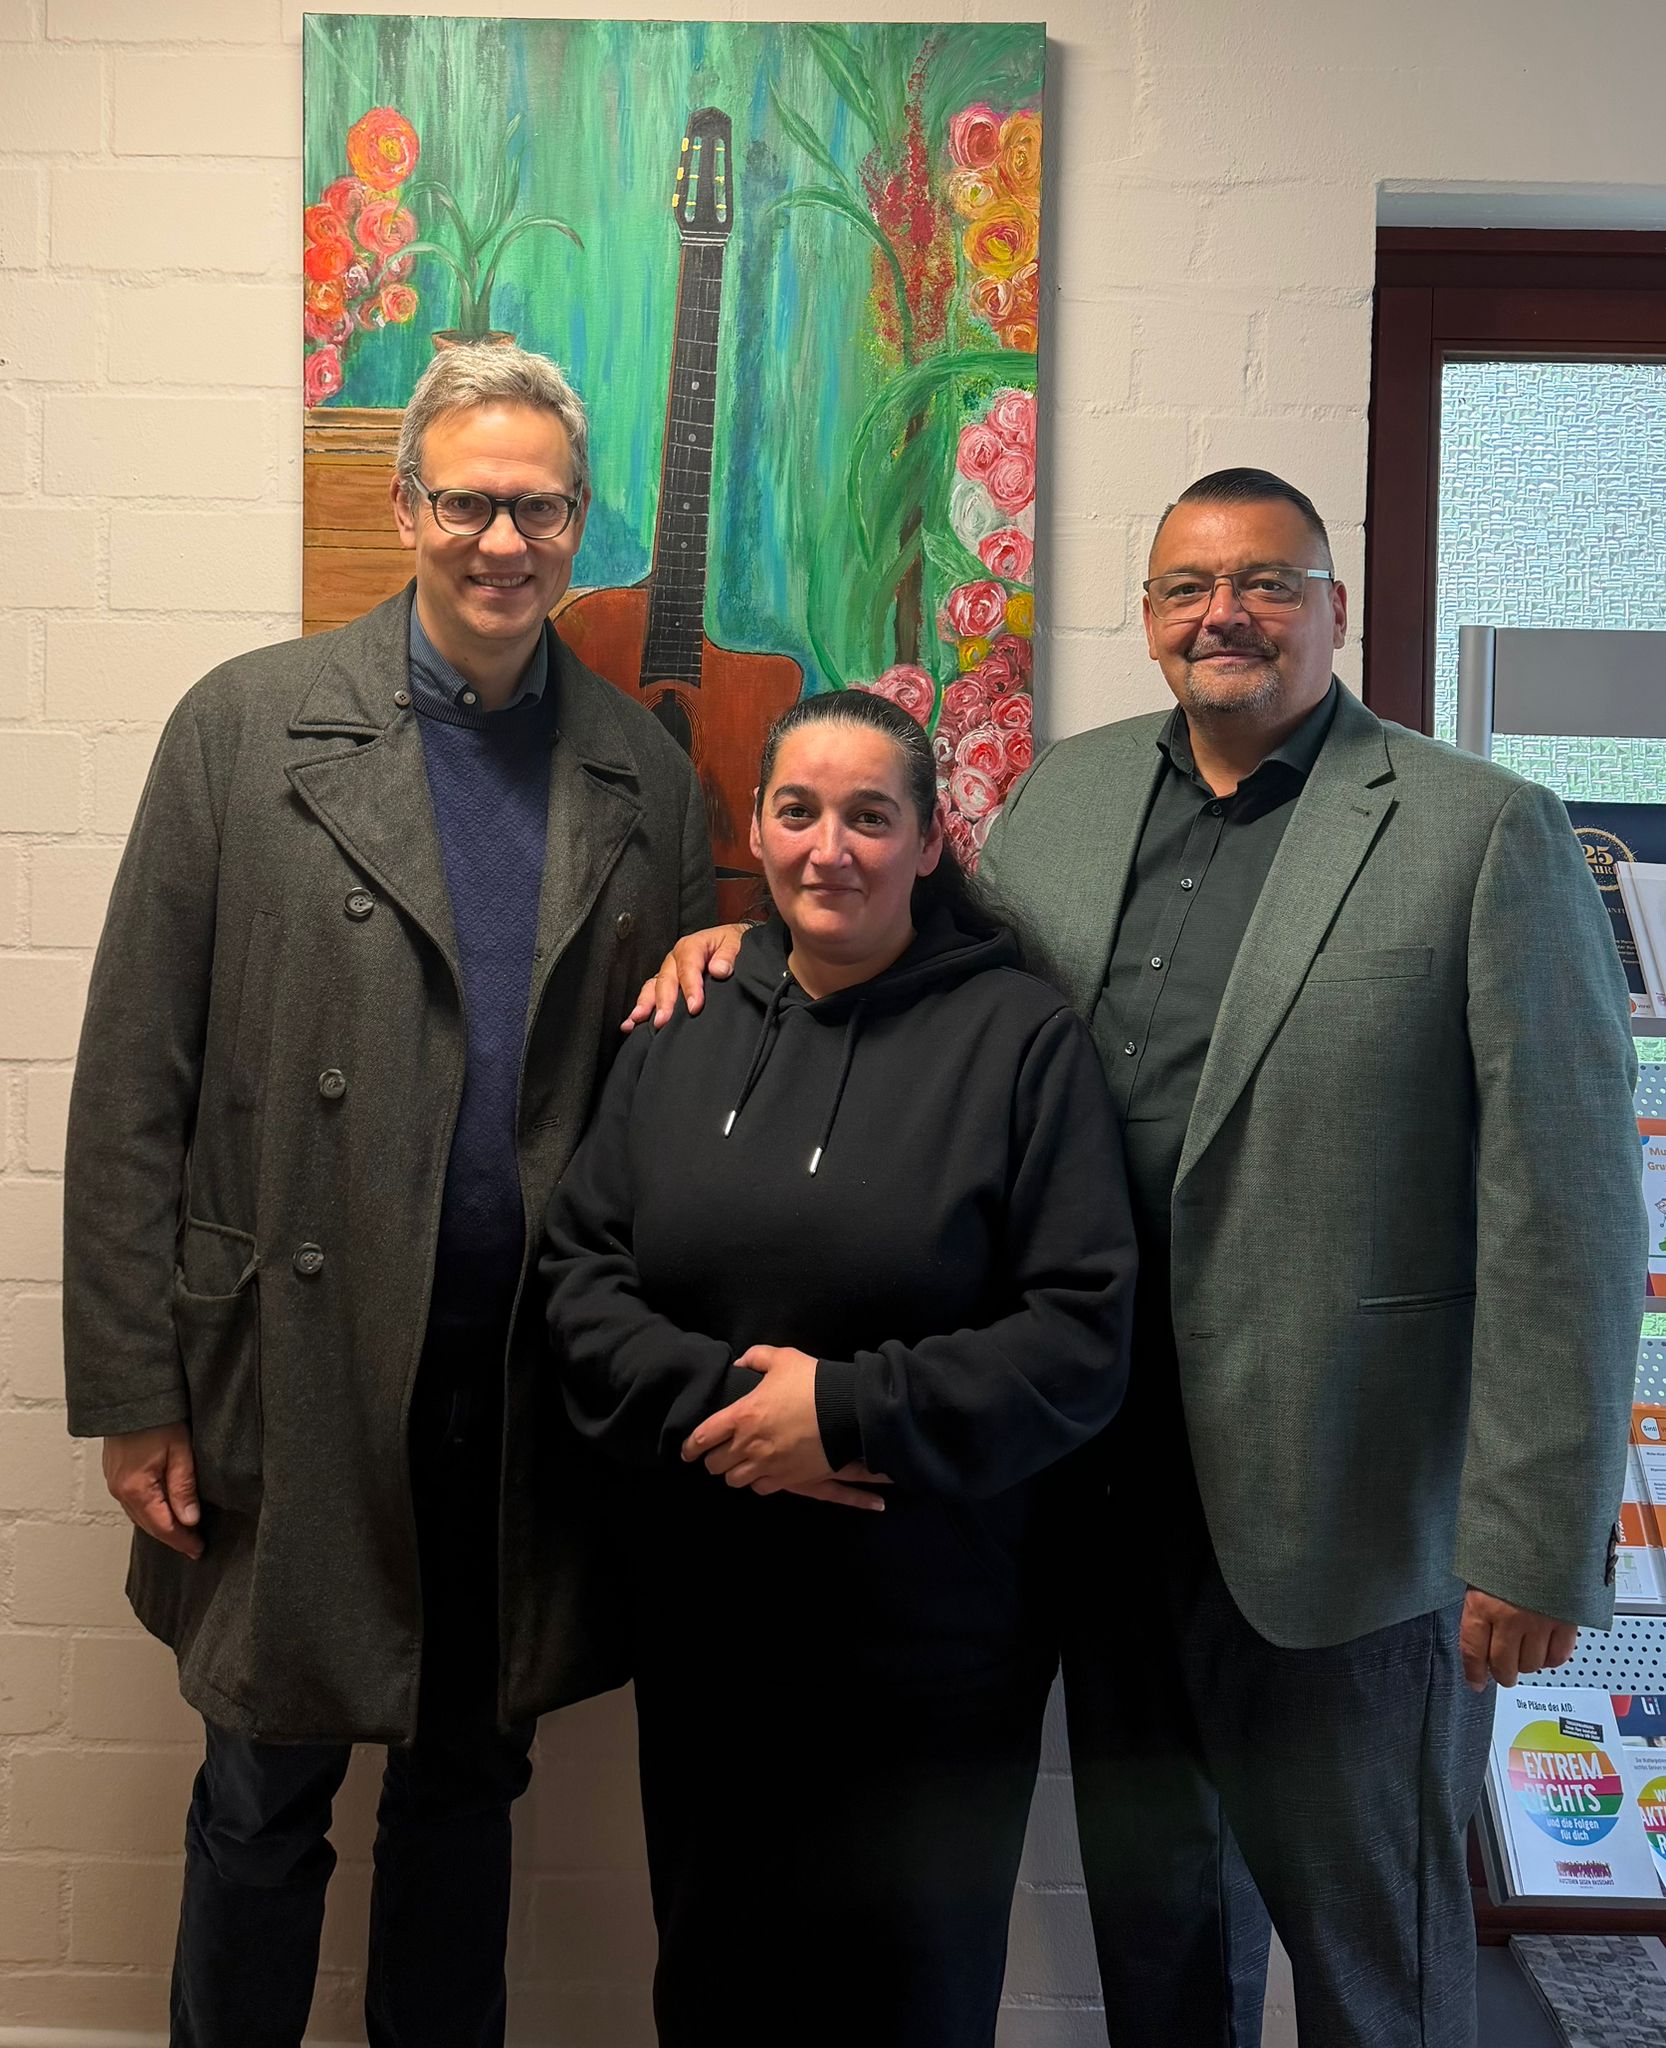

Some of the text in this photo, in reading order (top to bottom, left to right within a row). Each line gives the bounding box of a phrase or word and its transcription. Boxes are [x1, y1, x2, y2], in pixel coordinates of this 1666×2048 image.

[1581, 844, 1614, 865] 25
[1516, 1699, 1527, 1709] Die
[1528, 1700, 1547, 1711] Pläne
[1522, 1751, 1604, 1780] EXTREM
[1546, 1817, 1600, 1831] und die Folgen
[1560, 1829, 1590, 1841] für dich
